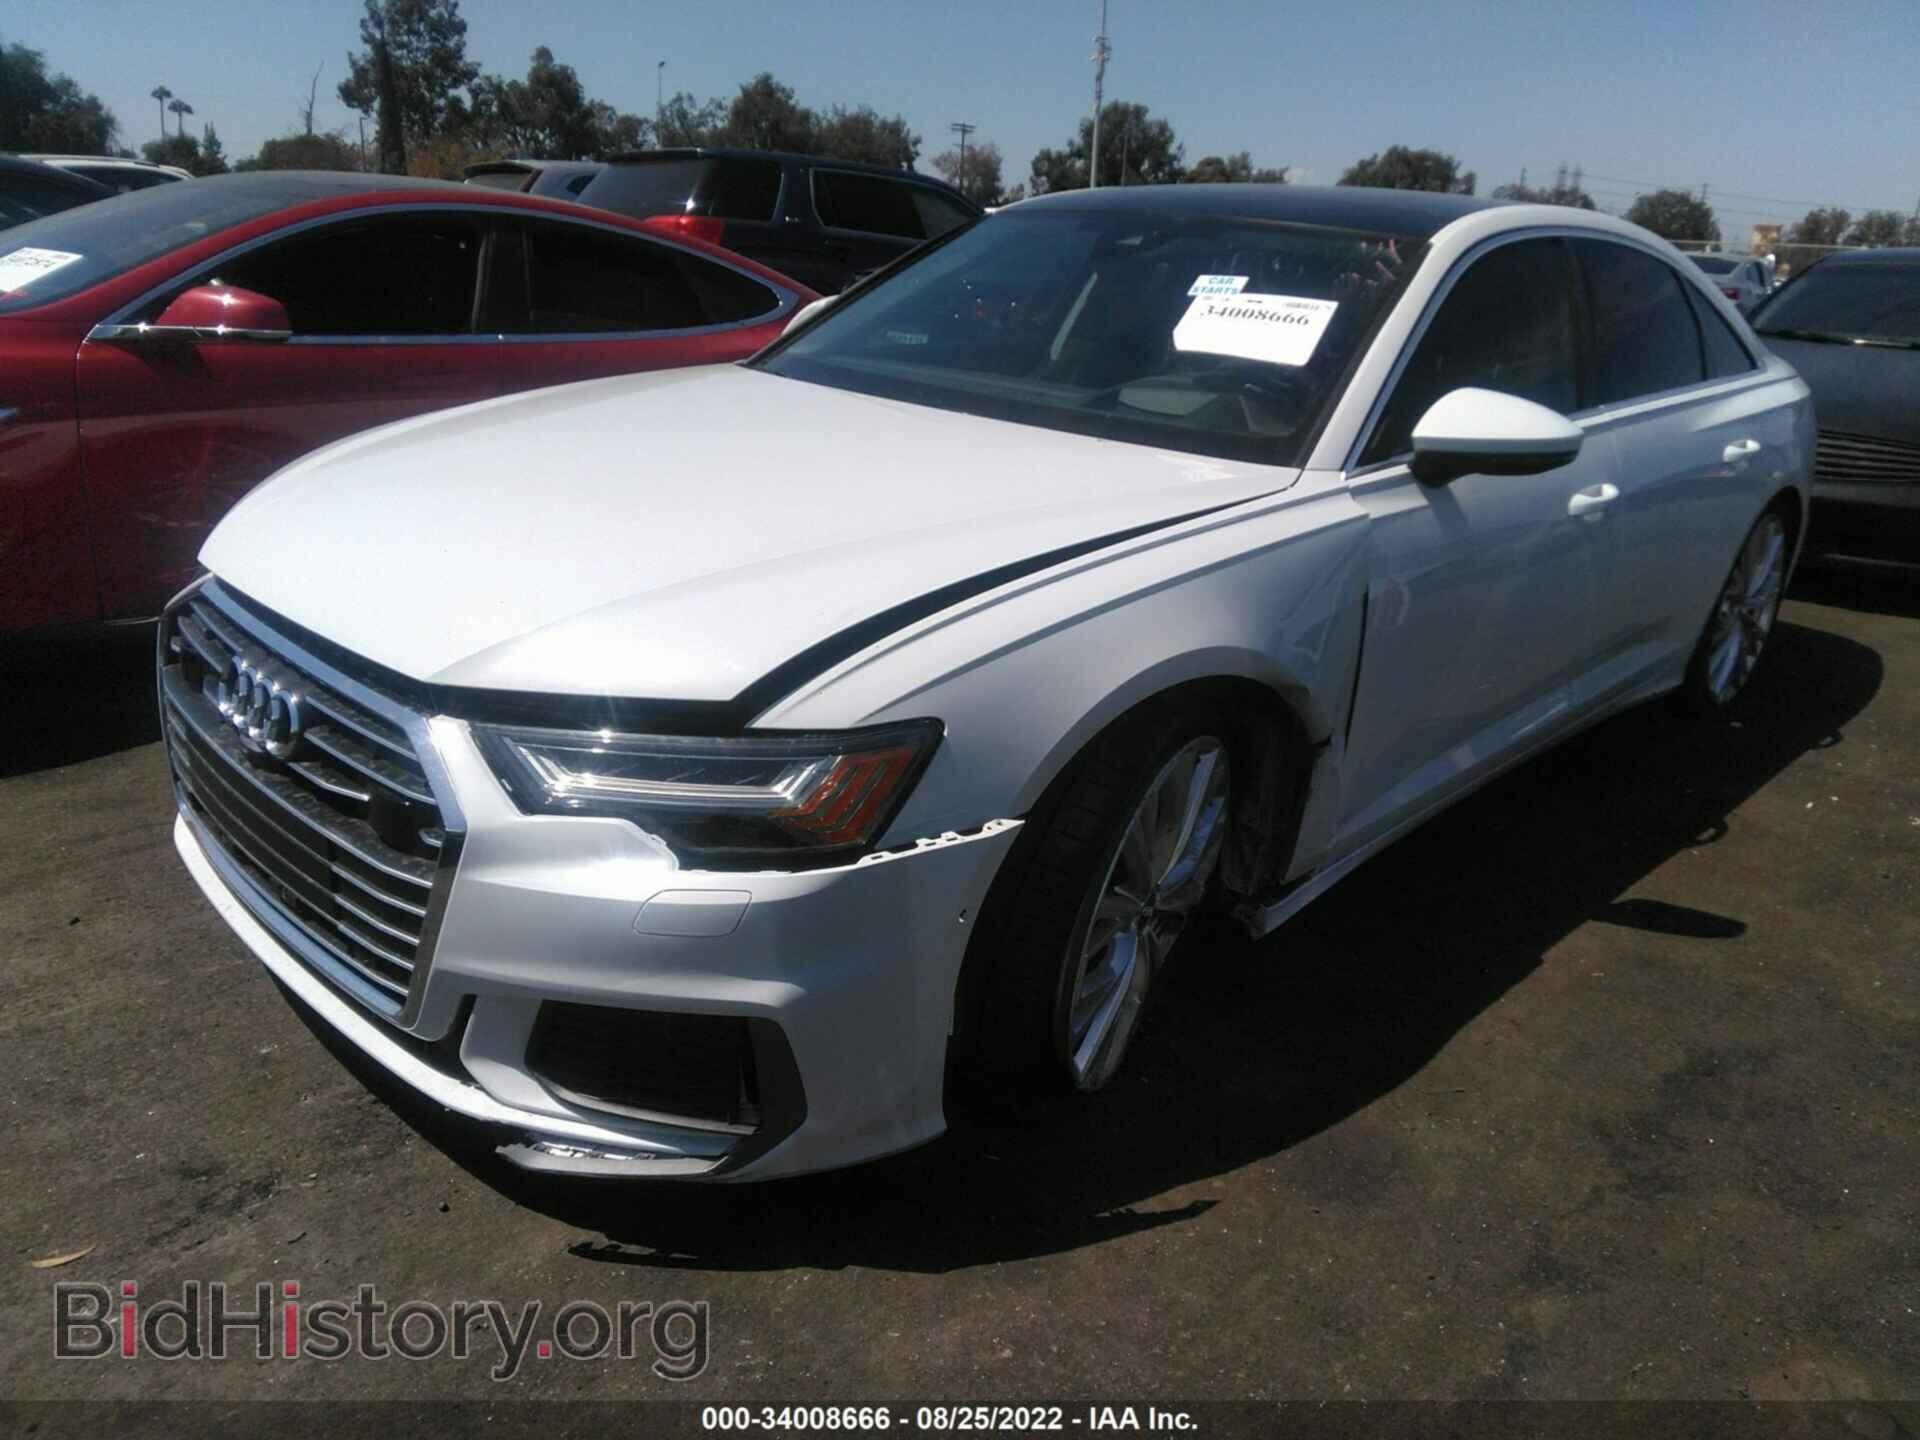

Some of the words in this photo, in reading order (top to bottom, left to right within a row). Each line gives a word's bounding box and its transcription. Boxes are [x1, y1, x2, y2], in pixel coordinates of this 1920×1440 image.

[1208, 276, 1234, 285] CAR
[1191, 287, 1239, 295] STARTS
[1201, 305, 1309, 326] 34008666
